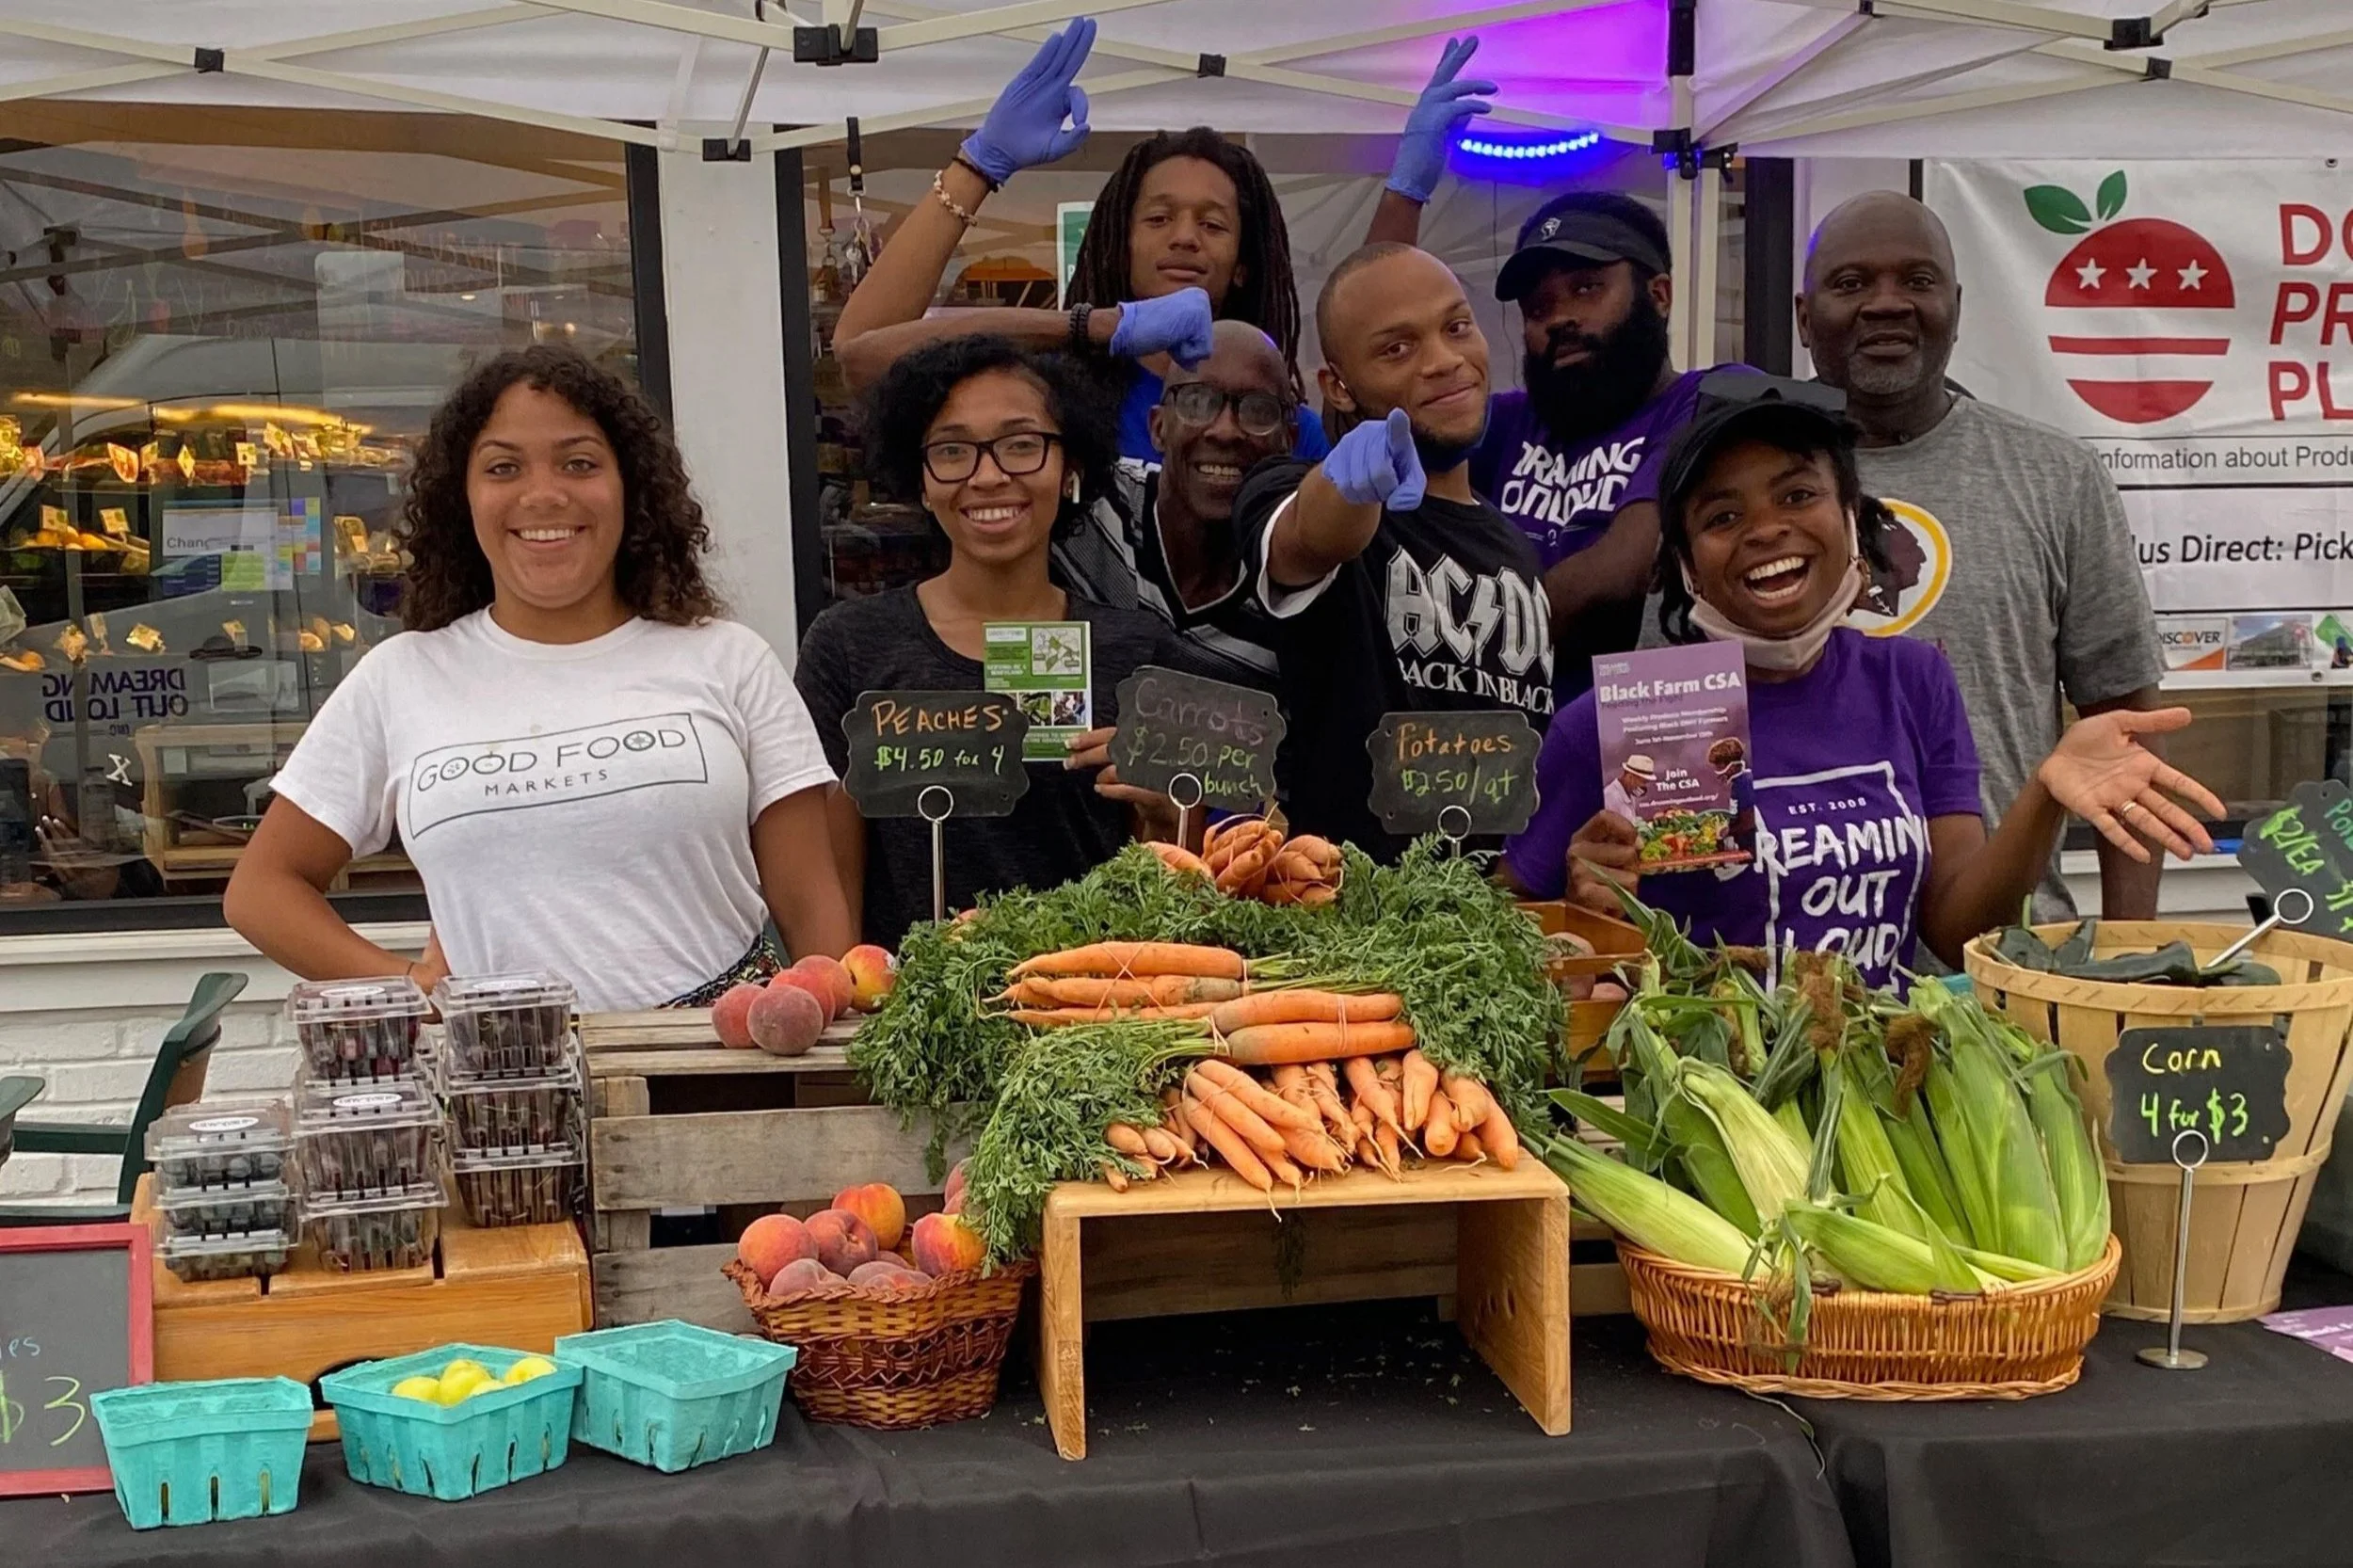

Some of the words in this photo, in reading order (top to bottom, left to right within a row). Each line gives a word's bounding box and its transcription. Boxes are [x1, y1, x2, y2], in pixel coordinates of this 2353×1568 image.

[2100, 447, 2217, 469] nformation
[2225, 447, 2288, 468] about
[2181, 534, 2282, 563] Direct:
[1473, 669, 1499, 698] IN
[1600, 680, 1650, 703] Black
[1653, 679, 1701, 697] Farm
[1704, 671, 1742, 691] CSA
[872, 699, 1000, 737] PEACHES
[1135, 678, 1269, 746] Carrots
[1127, 726, 1209, 768] $2.50
[1217, 744, 1257, 769] per
[1399, 722, 1512, 761] Potatoes
[417, 750, 537, 792] GOOD
[557, 728, 686, 768] FOOD
[873, 744, 945, 772] $4.50
[991, 744, 1005, 776] 4
[1665, 767, 1689, 781] Join
[485, 769, 610, 796] MARKETS
[1204, 771, 1264, 797] bunch
[1656, 781, 1677, 792] The
[1678, 777, 1701, 790] CSA
[1828, 796, 1867, 810] 2008
[1801, 869, 1900, 919] OUT
[2141, 1042, 2222, 1075] Corn
[2140, 1092, 2160, 1138] 4
[2168, 1098, 2201, 1132] for
[2206, 1086, 2249, 1145] $3
[0, 1336, 41, 1357] es
